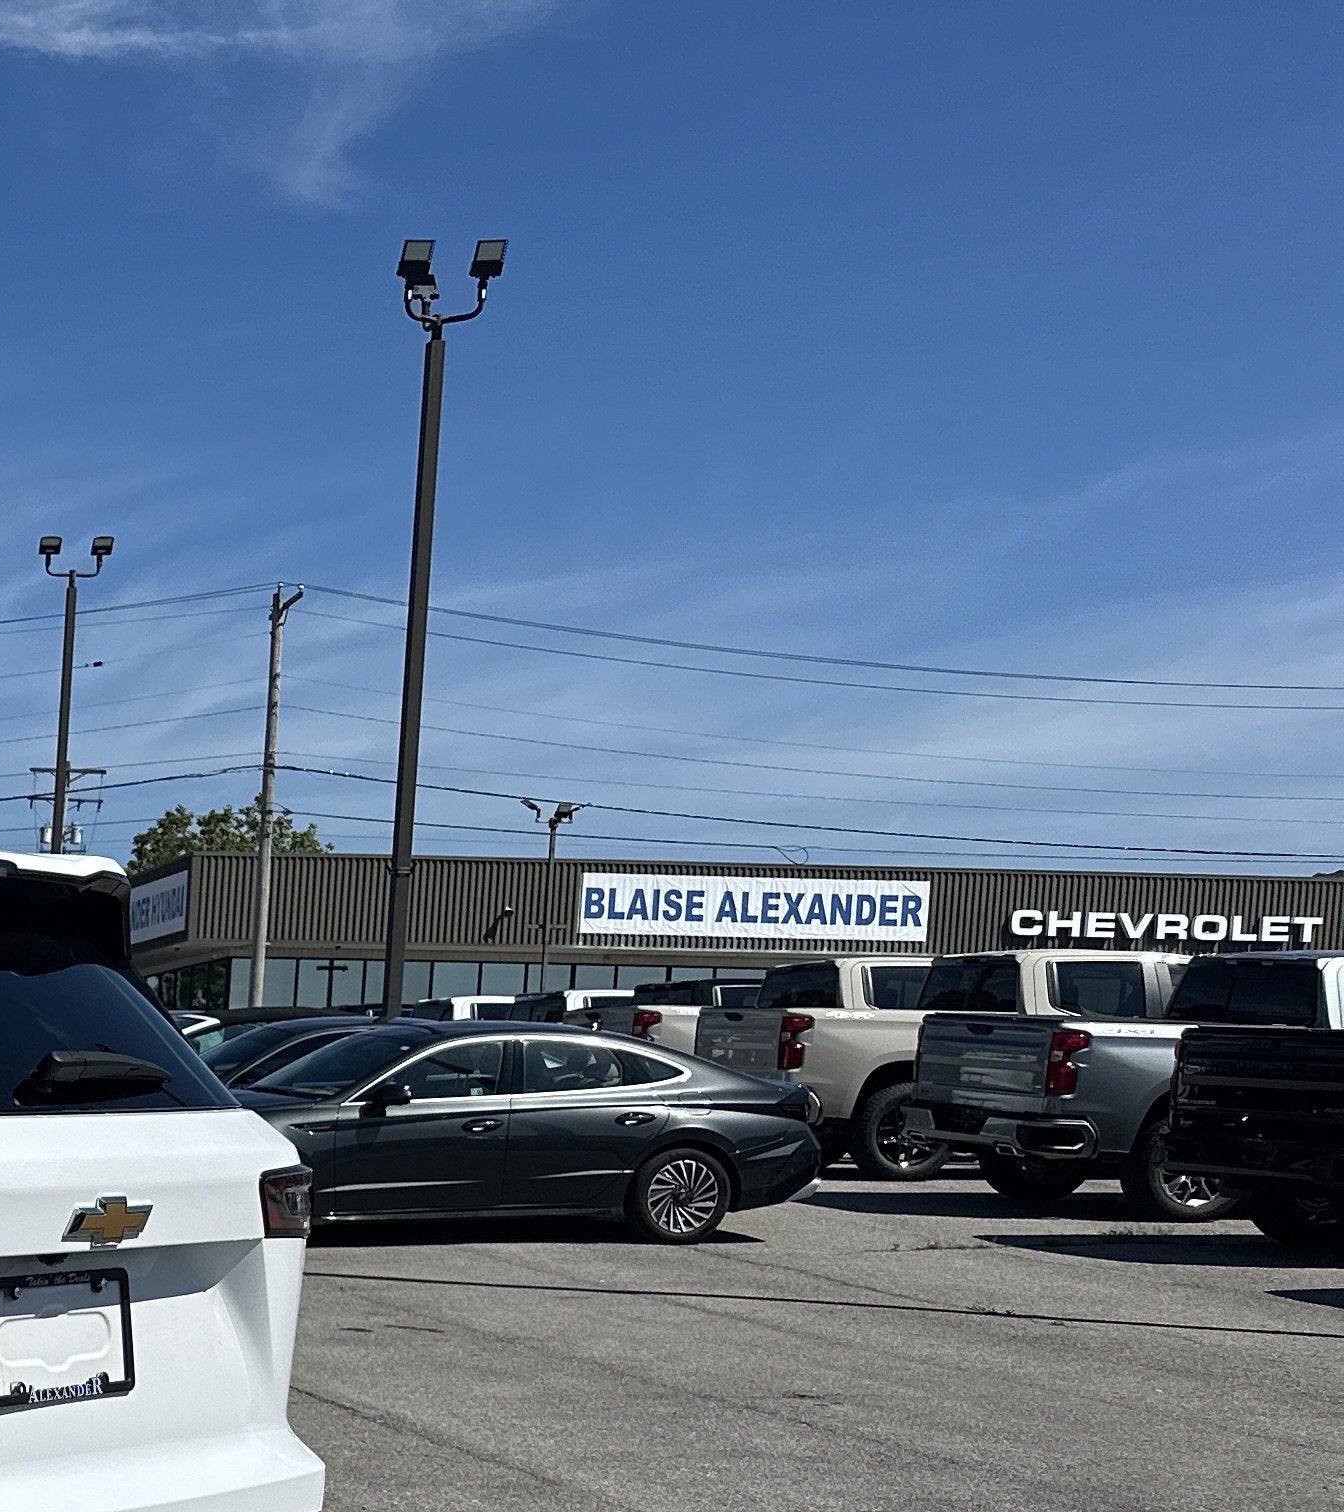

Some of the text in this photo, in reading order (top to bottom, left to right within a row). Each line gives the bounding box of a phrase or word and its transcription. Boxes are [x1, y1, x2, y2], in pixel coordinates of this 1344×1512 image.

[583, 886, 924, 927] BLAISE ALEXANDER
[1010, 909, 1324, 943] CHEVROLET
[28, 1377, 103, 1405] ALEXANDER
